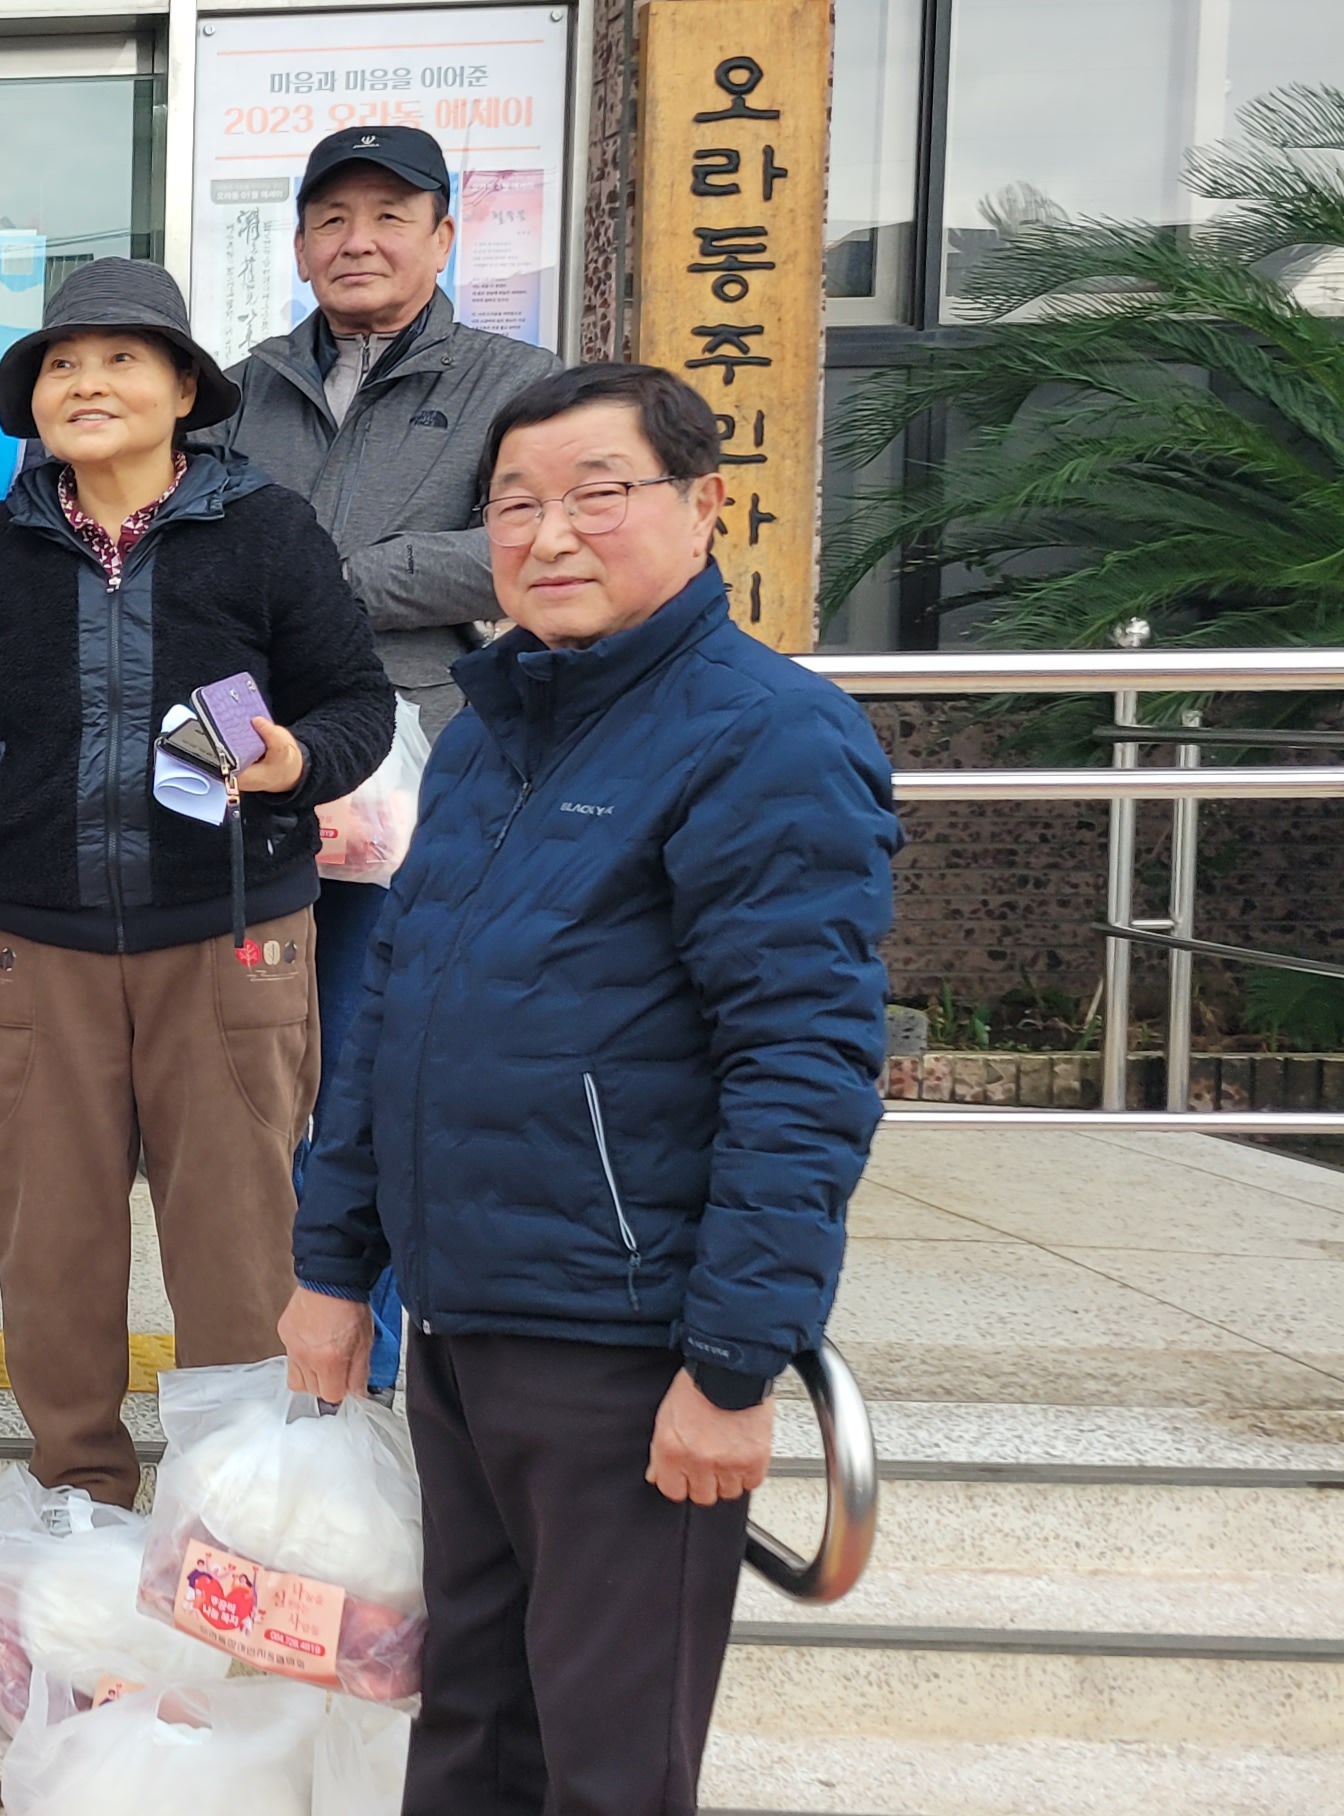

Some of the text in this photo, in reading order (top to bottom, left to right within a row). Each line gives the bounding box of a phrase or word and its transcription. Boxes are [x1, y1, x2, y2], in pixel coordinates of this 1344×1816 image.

[269, 65, 488, 95] 마음과 마음을 이어준
[223, 96, 533, 136] 2023 오라동 에세이
